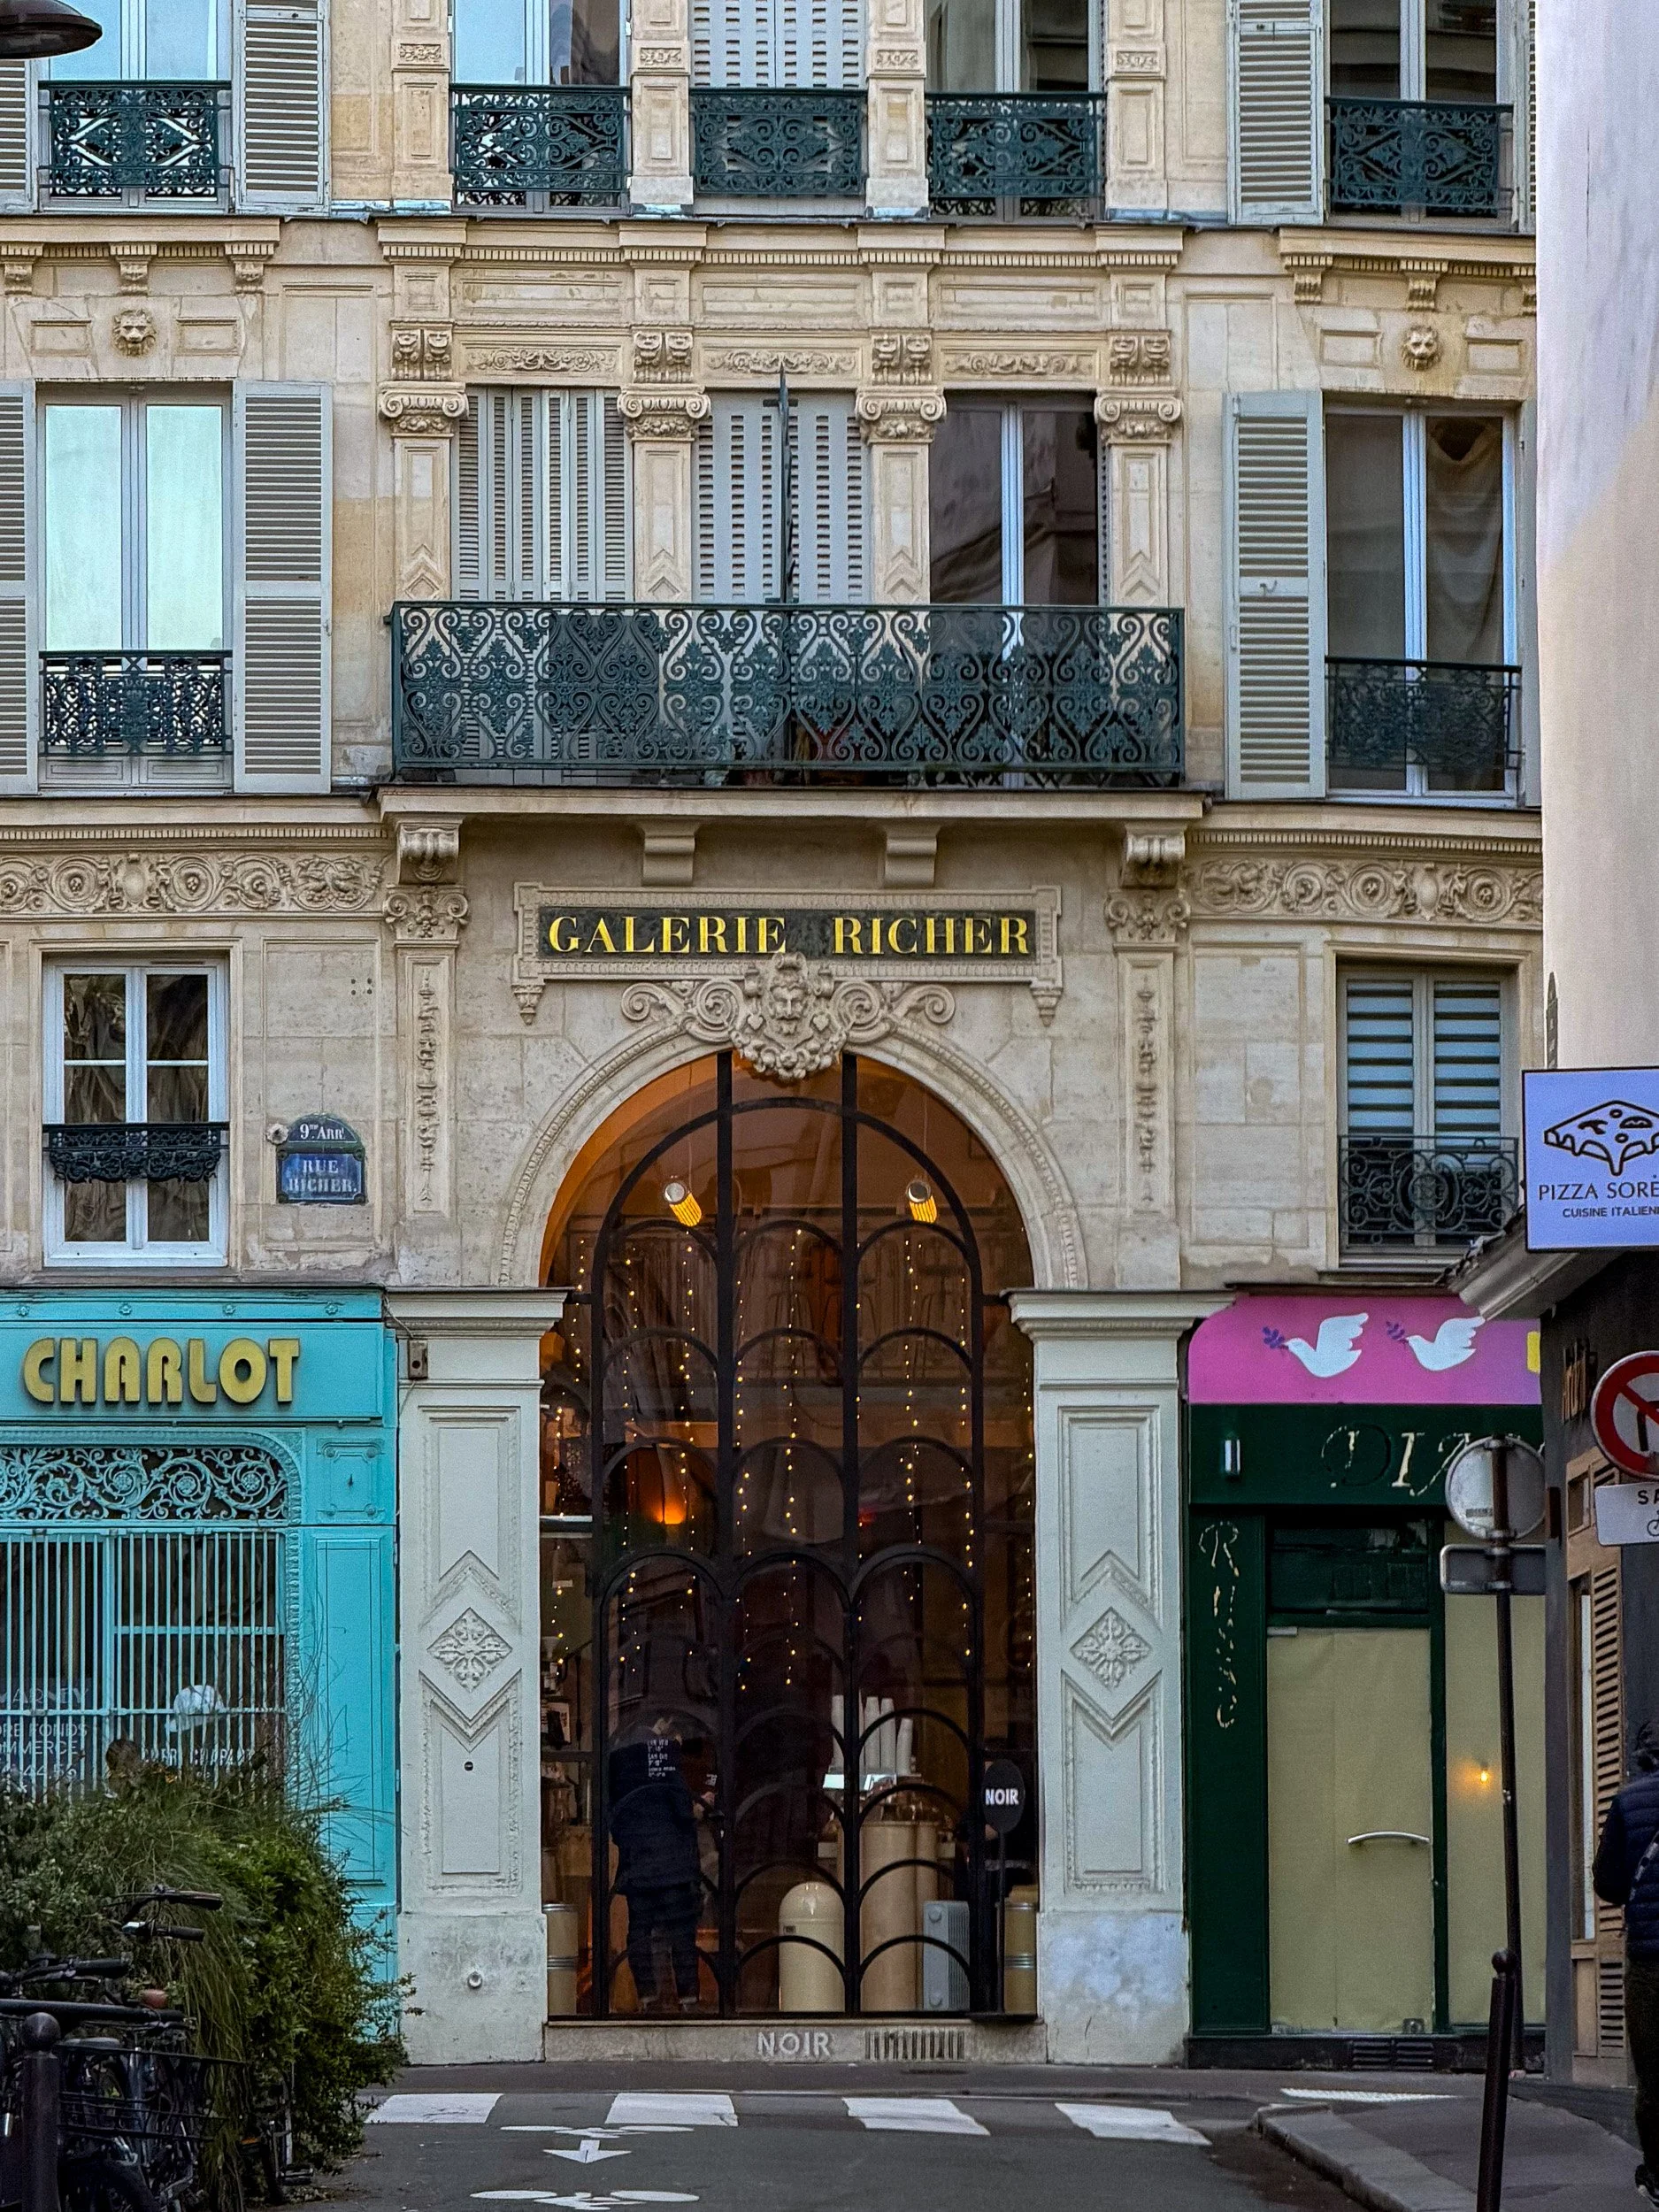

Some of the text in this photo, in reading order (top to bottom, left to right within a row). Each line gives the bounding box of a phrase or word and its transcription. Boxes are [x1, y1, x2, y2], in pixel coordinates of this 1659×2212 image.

[549, 916, 1030, 955] GALERIE RICHER
[303, 1159, 339, 1173] RUE
[1538, 1183, 1599, 1201] PIZZA
[1562, 1205, 1659, 1218] CUISINE ITALIEN
[23, 1335, 301, 1404] CHARLOT
[0, 1740, 79, 1755] MMERCE
[985, 1788, 1019, 1805] NOIR
[757, 2032, 832, 2058] NOIR
